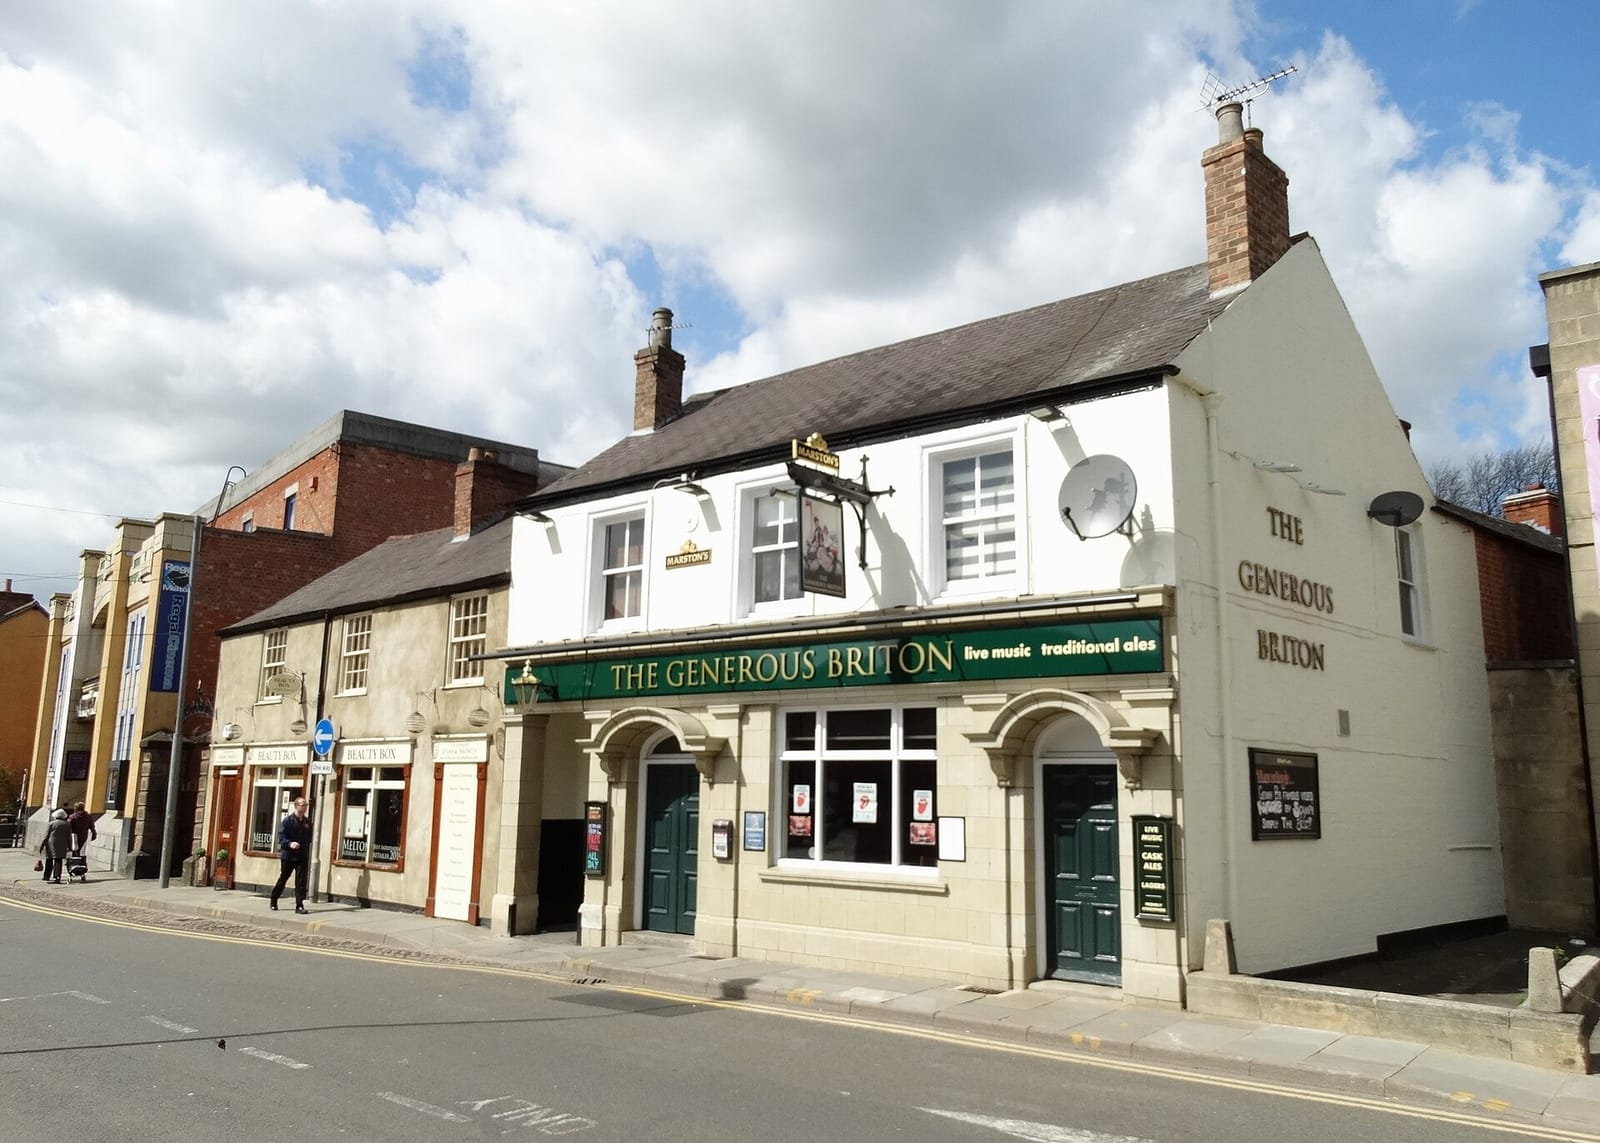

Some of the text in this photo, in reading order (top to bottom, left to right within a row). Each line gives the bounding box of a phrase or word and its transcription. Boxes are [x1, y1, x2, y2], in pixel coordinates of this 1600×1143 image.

[799, 447, 838, 467] MARSTON'S
[1266, 506, 1304, 545] THE
[667, 551, 709, 566] MARSTON'S
[1238, 560, 1334, 614] GENEROUS
[964, 635, 1157, 660] live music traditional ales
[1257, 629, 1325, 671] BRITON
[611, 640, 954, 691] THE GENEROUS BRITON
[257, 750, 297, 761] BEAUTY BOX
[347, 748, 396, 761] BEAUTY BOX
[253, 831, 272, 844] MELTO
[1140, 834, 1164, 842] MUSIC
[1141, 852, 1164, 861] CASK
[1143, 862, 1163, 871] ALES
[1141, 881, 1166, 890] LAGERS
